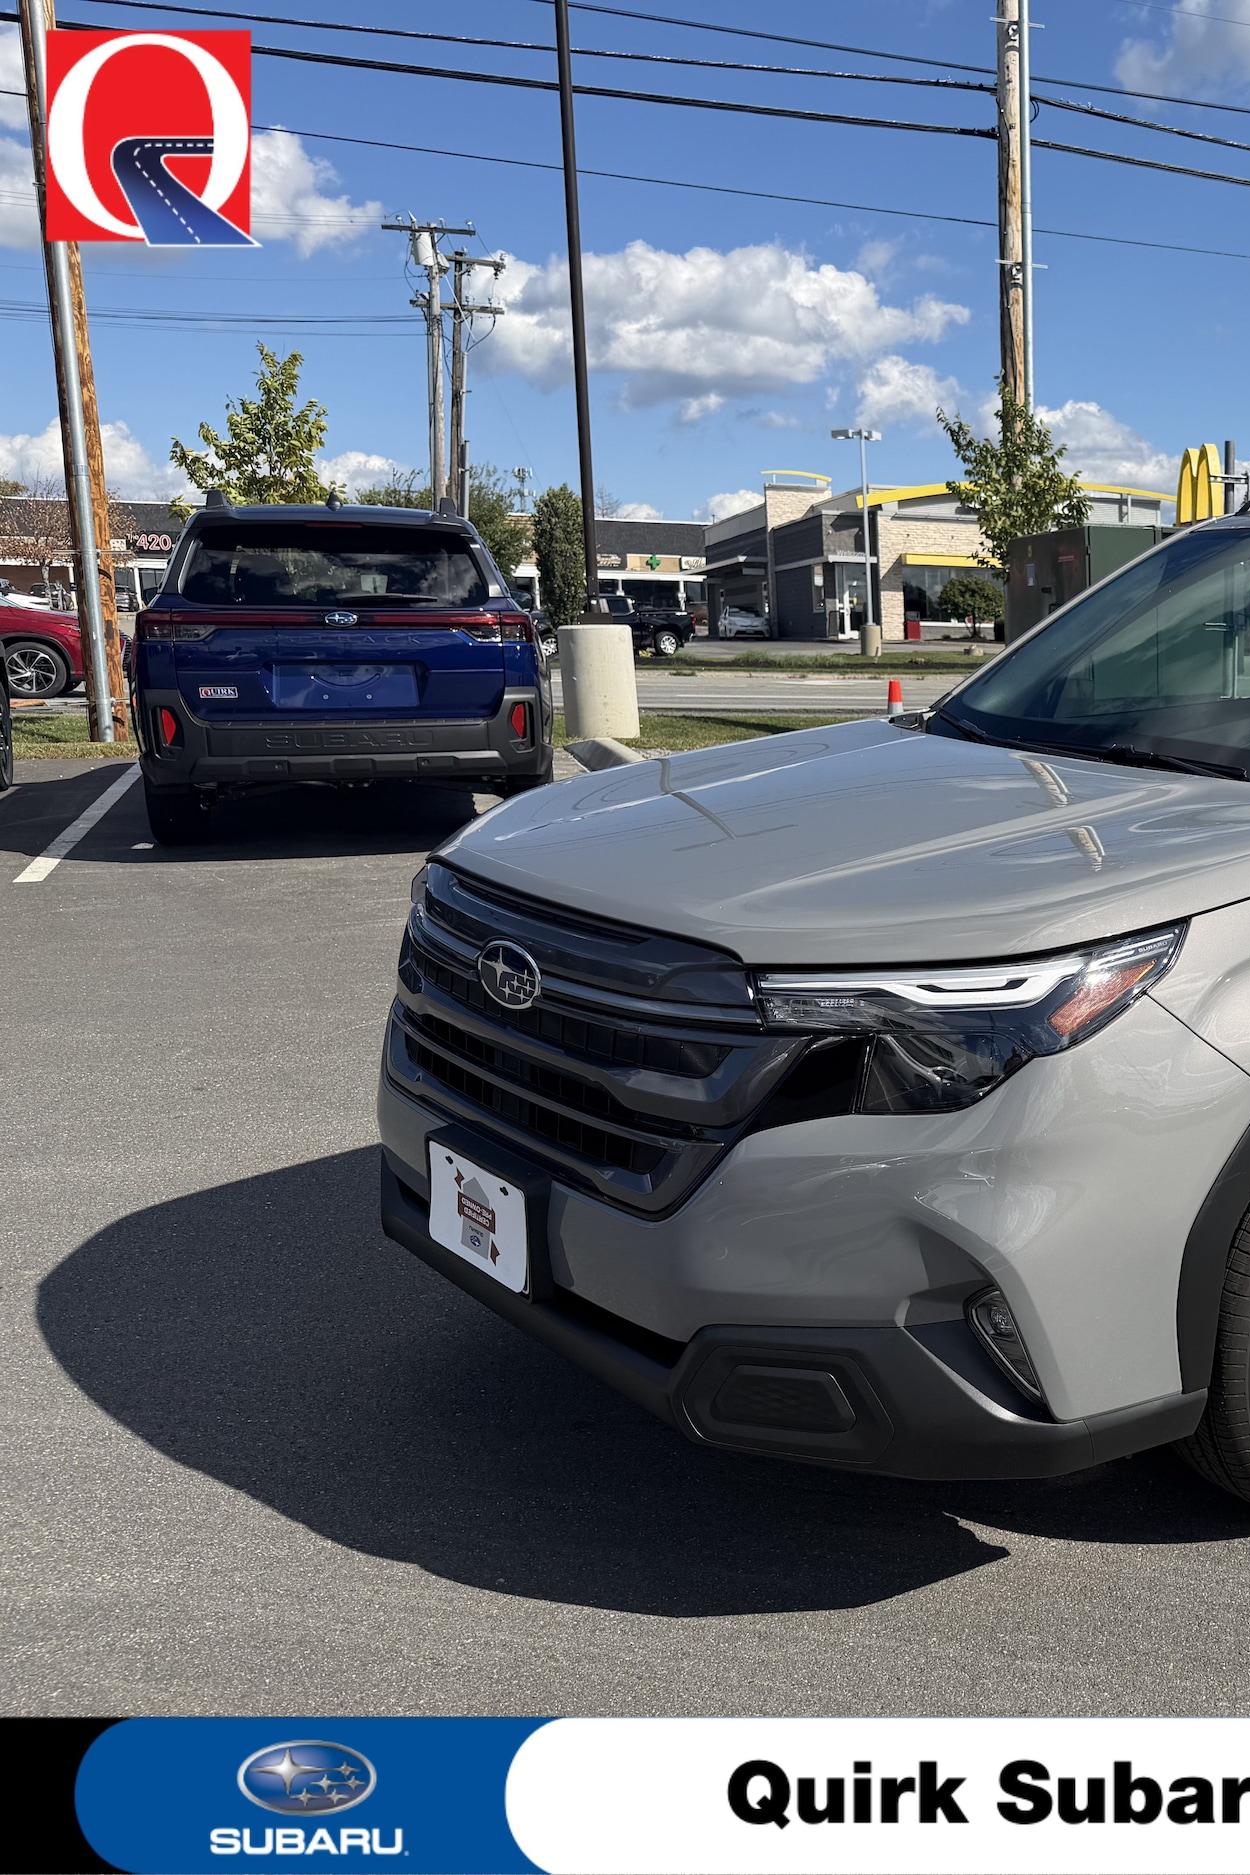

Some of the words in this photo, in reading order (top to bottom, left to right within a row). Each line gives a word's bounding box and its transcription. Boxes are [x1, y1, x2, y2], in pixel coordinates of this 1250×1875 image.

[136, 533, 172, 551] 420
[263, 634, 421, 645] OUTBACK
[201, 688, 236, 697] QUIRK
[265, 731, 434, 749] SUBARU
[1137, 941, 1168, 953] SUBARU
[461, 1197, 492, 1220] PRE-OWNED
[463, 1206, 490, 1227] CERTIFIED
